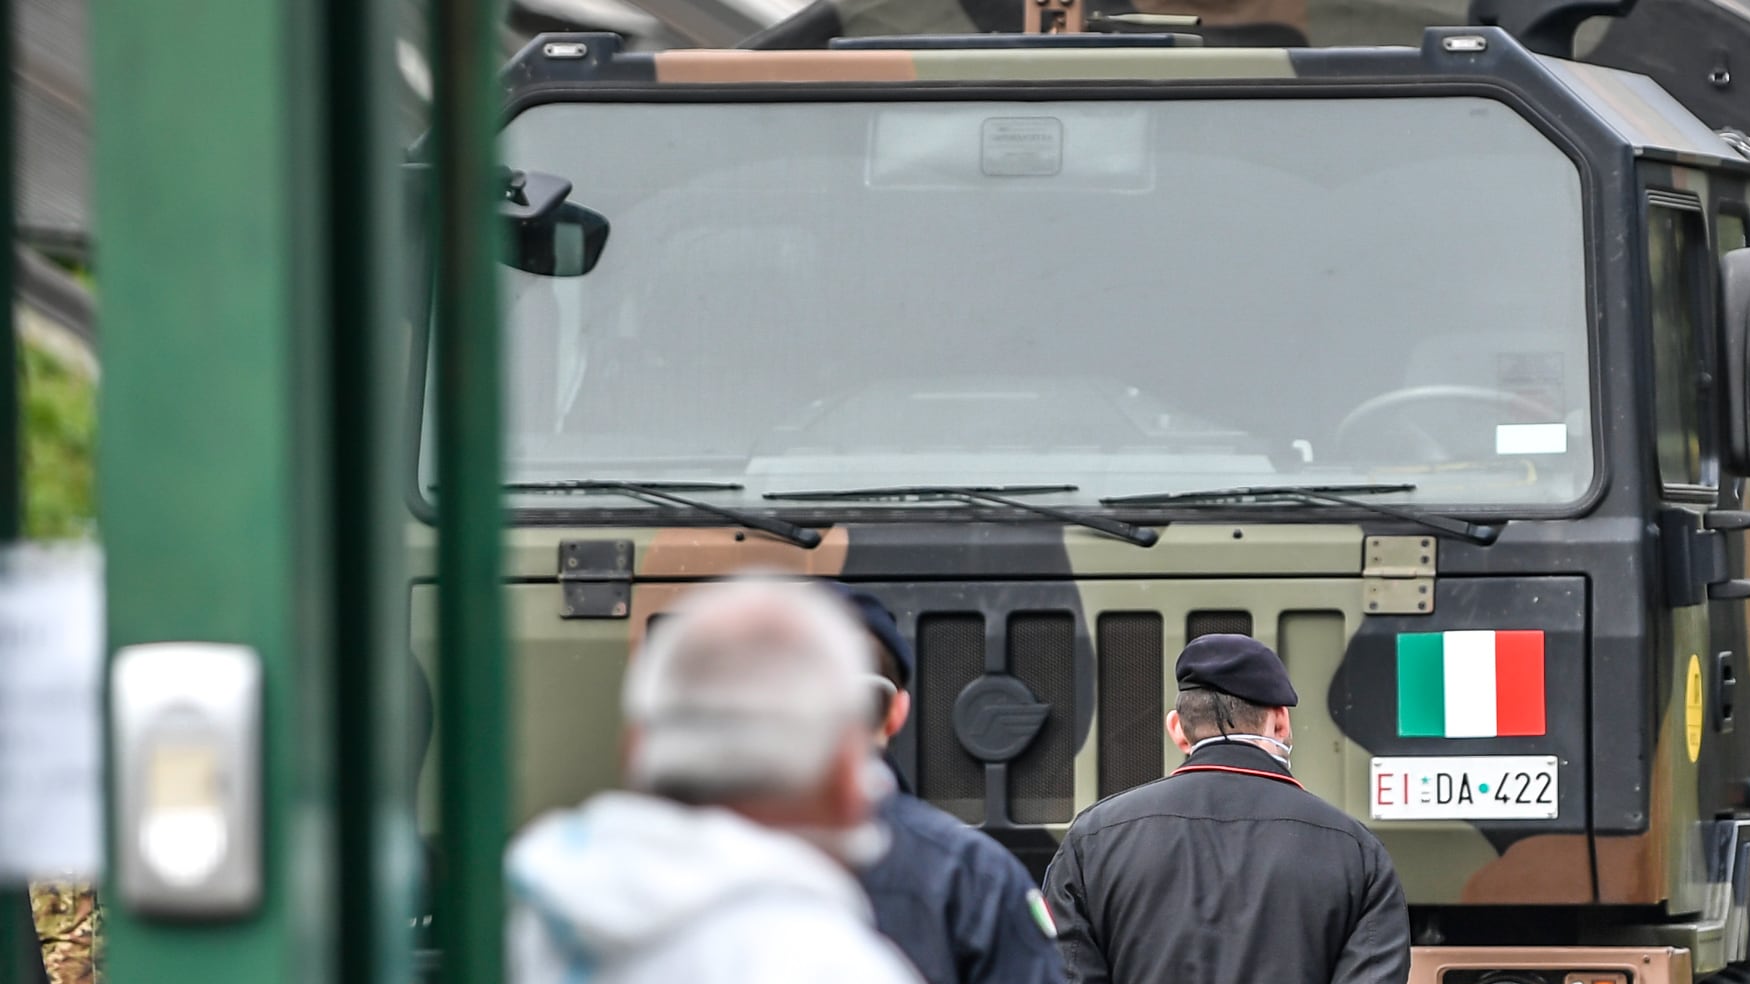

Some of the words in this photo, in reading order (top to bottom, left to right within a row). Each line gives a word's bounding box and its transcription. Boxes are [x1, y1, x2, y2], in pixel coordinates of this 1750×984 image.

[1377, 772, 1408, 805] EI
[1436, 772, 1474, 805] DA
[1494, 771, 1553, 804] 422
